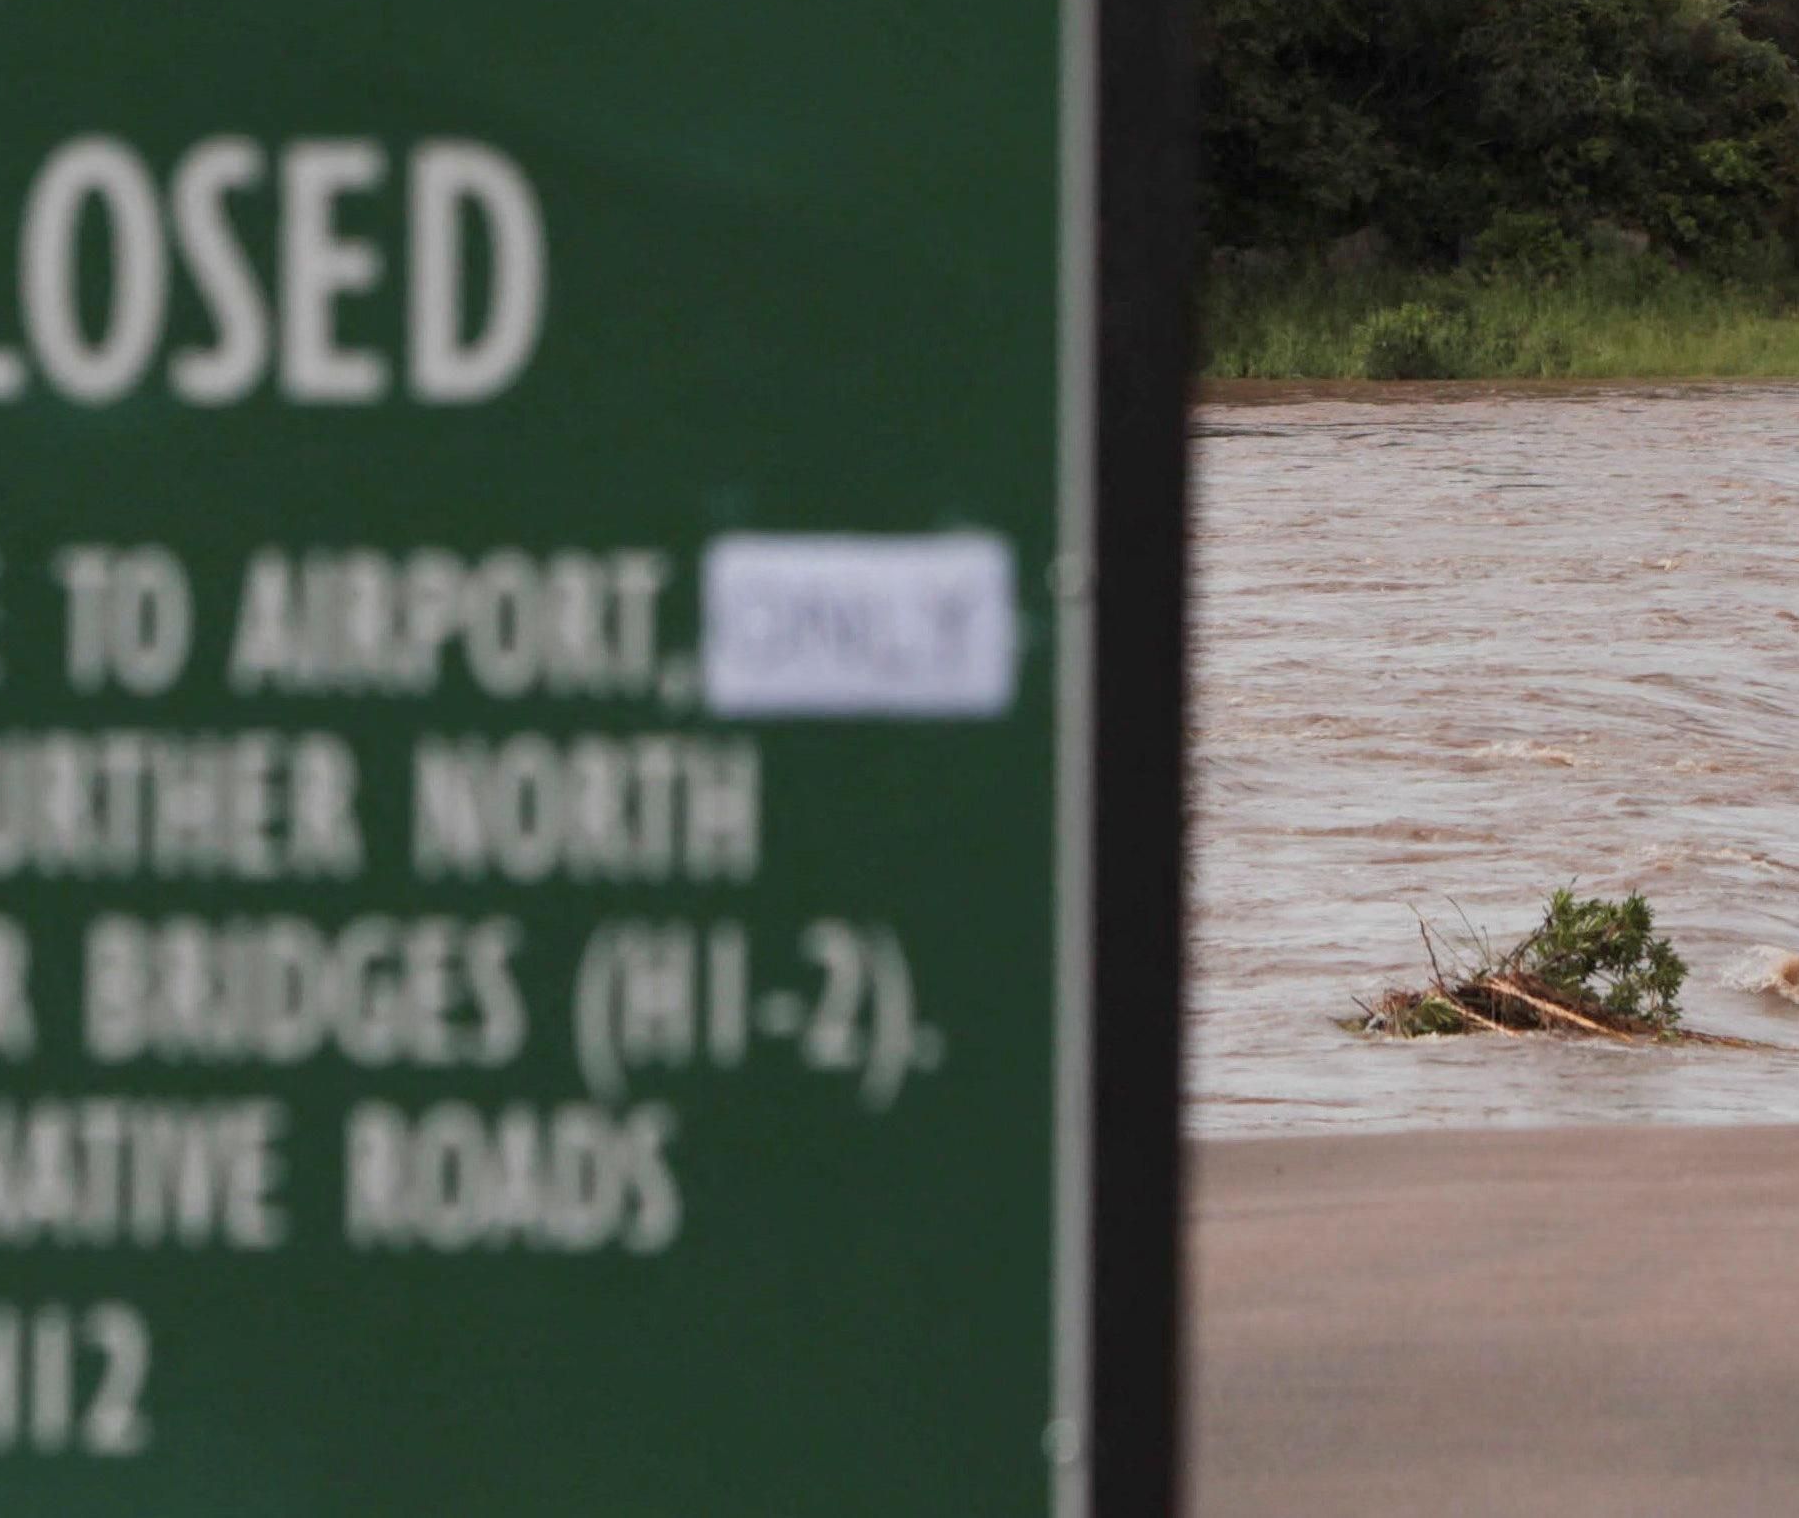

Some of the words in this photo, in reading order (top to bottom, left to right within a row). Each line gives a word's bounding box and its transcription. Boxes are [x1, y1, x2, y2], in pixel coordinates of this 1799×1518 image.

[57, 544, 194, 694] TO
[411, 732, 763, 882] NORTH
[82, 915, 528, 1067] BRIDGES
[343, 1100, 682, 1254] ROADS
